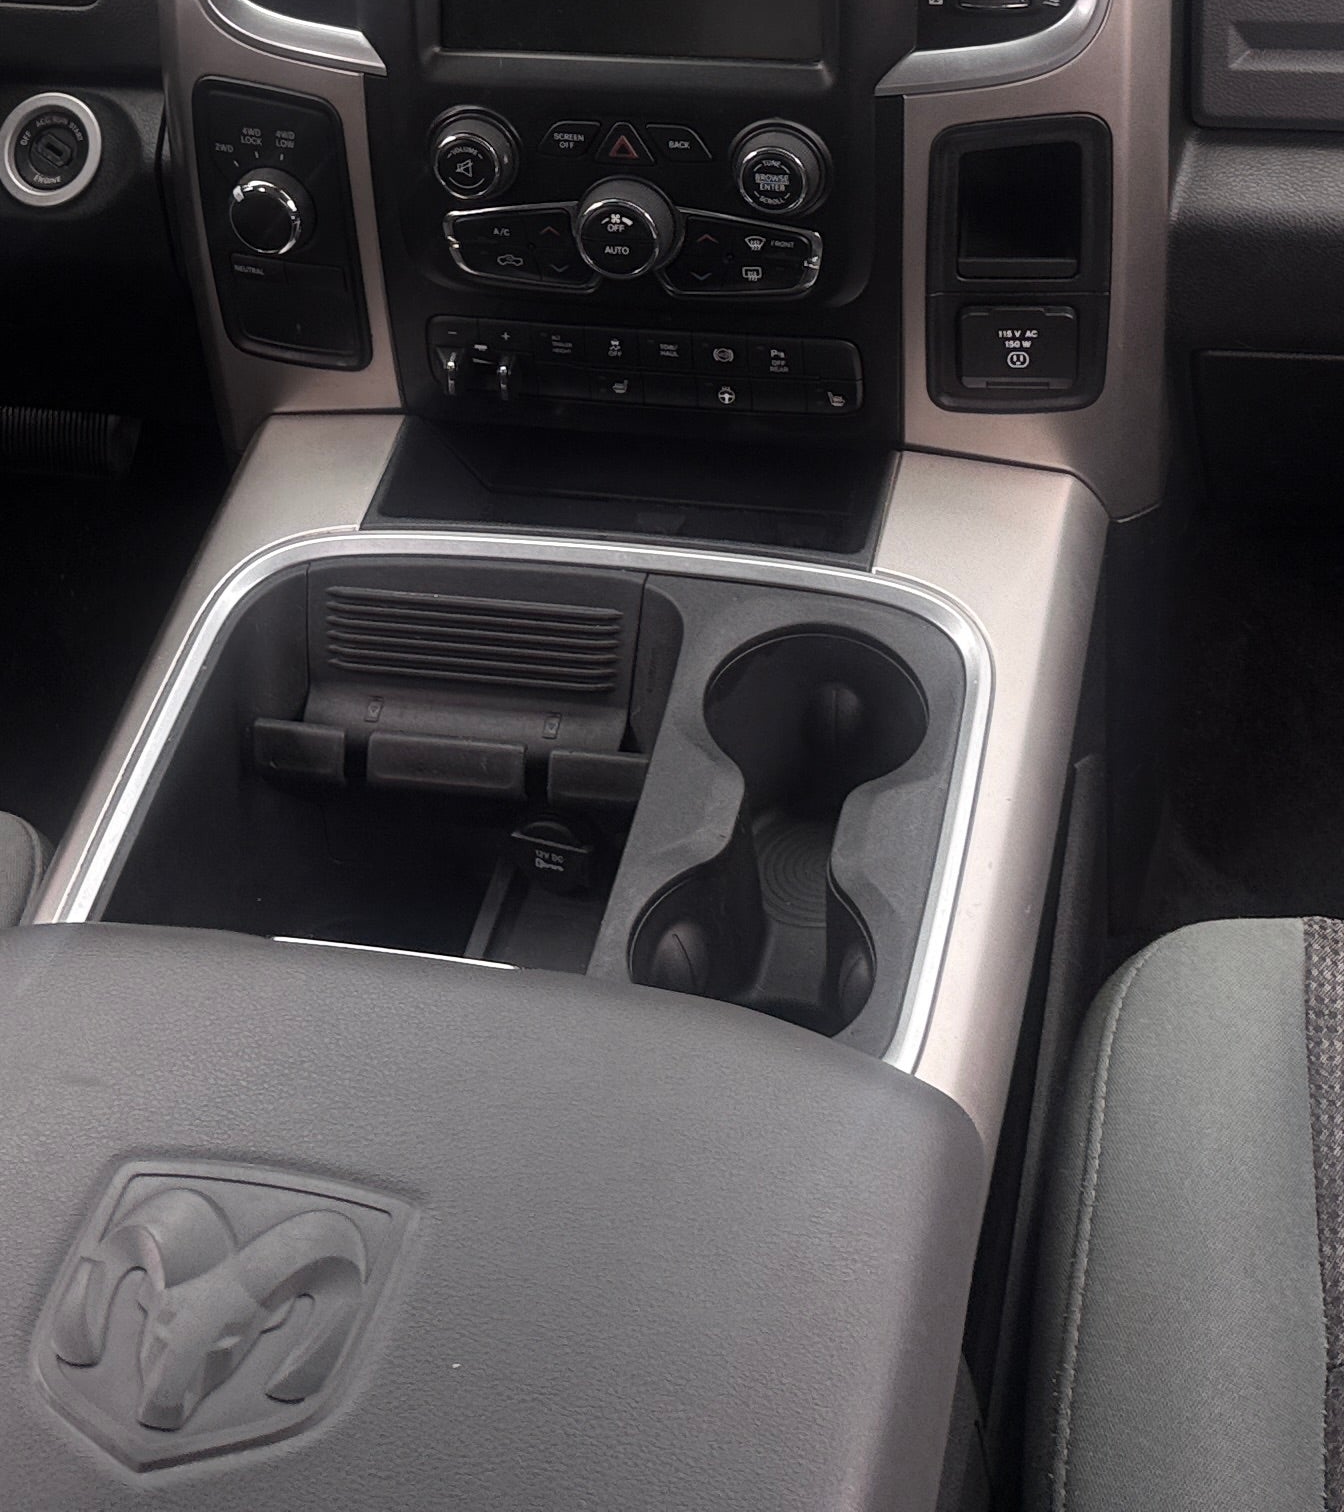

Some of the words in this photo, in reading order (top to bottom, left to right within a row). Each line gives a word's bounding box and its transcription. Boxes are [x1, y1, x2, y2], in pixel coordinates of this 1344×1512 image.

[240, 135, 263, 147] LOCK
[553, 132, 585, 142] SCREEN
[215, 142, 234, 153] 2WD
[275, 138, 295, 149] LOW
[559, 141, 574, 149] OFF
[668, 140, 691, 149] BACK
[755, 173, 791, 184] BROWSE
[758, 183, 787, 192] ENTER
[492, 227, 512, 237] A/C
[606, 223, 626, 233] OFF
[770, 240, 795, 249] FRONT
[604, 245, 631, 256] AUTO
[1013, 329, 1022, 338] V
[1025, 329, 1039, 338] AC
[1021, 340, 1032, 348] W
